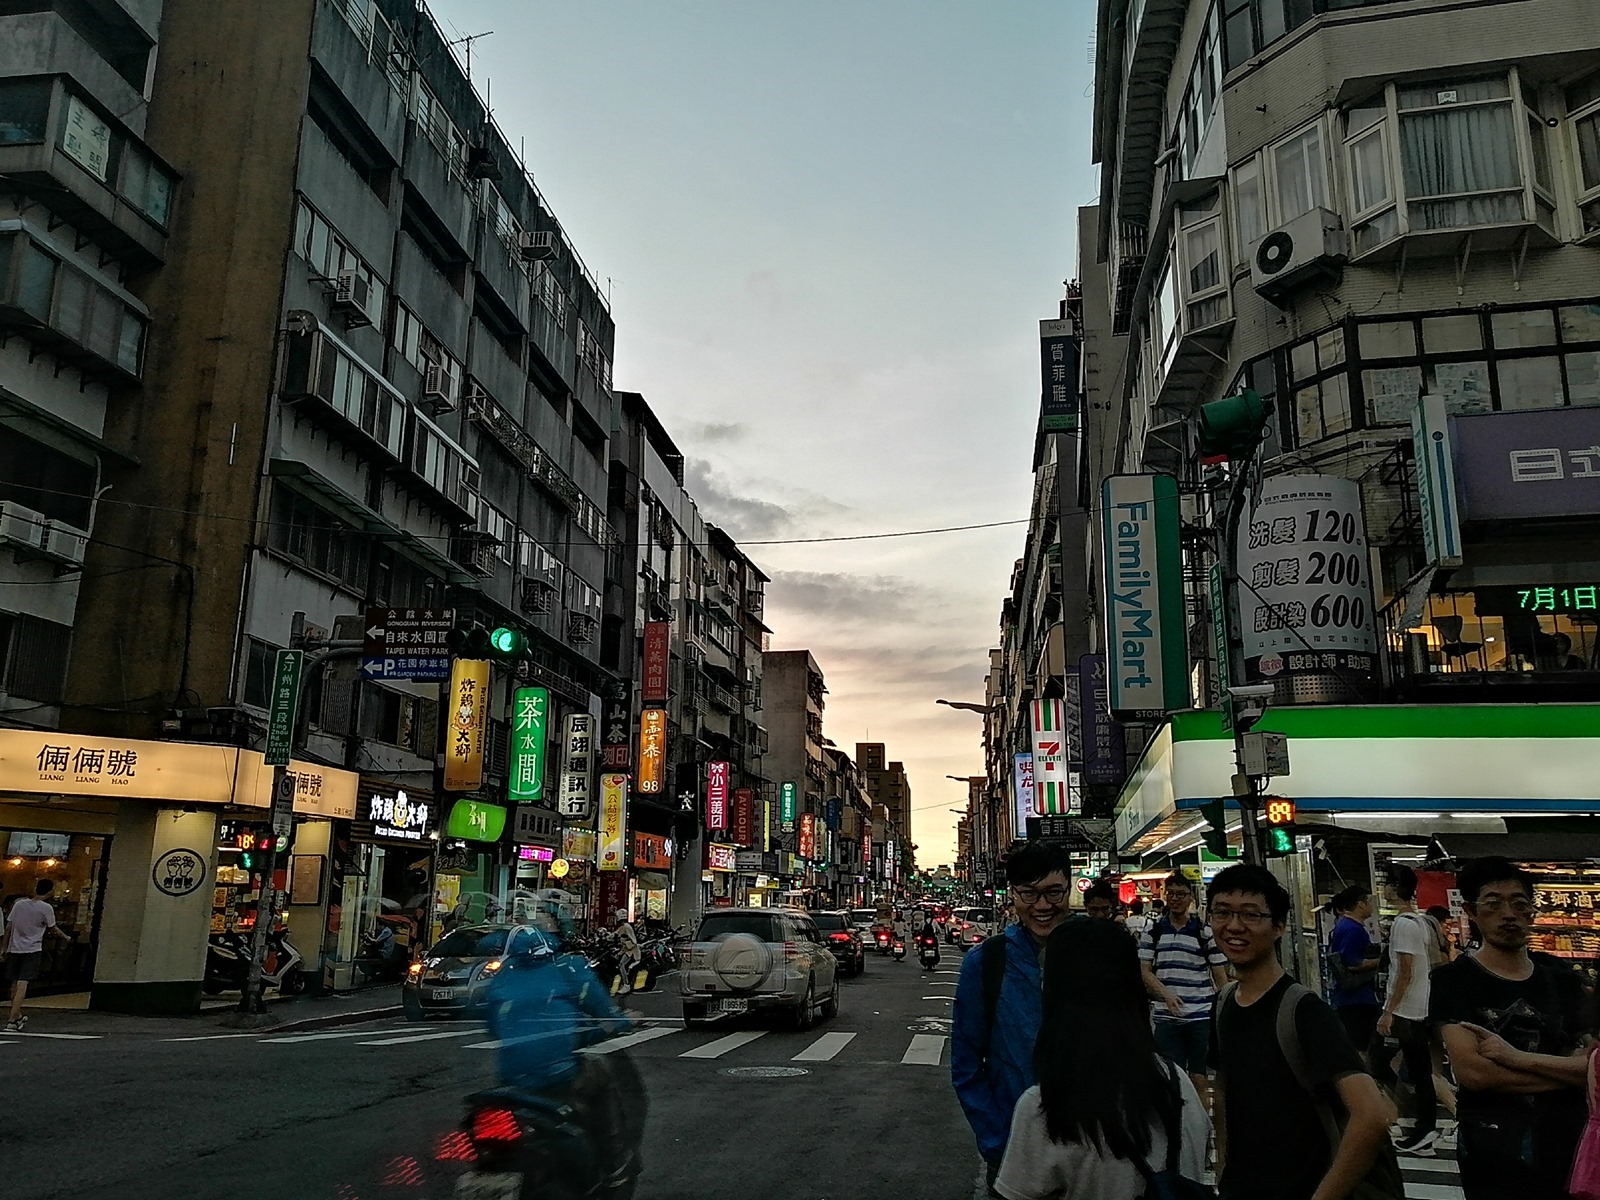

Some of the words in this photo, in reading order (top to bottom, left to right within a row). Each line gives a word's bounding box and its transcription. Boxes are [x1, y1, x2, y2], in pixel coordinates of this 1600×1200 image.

[1051, 343, 1067, 402] 質菲雅
[1249, 516, 1297, 550] 洗髮
[1302, 509, 1356, 544] 120
[1252, 558, 1299, 590] 剪髮
[1305, 551, 1360, 586] 200
[1113, 503, 1153, 688] FamilyMart
[1254, 601, 1306, 633] 設計染
[1310, 594, 1364, 629] 600
[385, 630, 449, 644] 自來水園區
[385, 647, 406, 655] TAIPEI
[407, 647, 430, 655] WATER
[431, 647, 449, 655] PARK
[397, 658, 449, 668] 花園停車場
[276, 661, 294, 723] 汀州路三段
[1135, 710, 1165, 718] STORE
[515, 697, 544, 794] 茶水間
[602, 747, 629, 767] 刻印
[36, 744, 138, 777] 倆倆號
[39, 774, 64, 782] LIANG
[76, 775, 100, 784] LIANG
[111, 777, 129, 786] HAO
[642, 780, 659, 792] 98
[1268, 802, 1291, 824] 89
